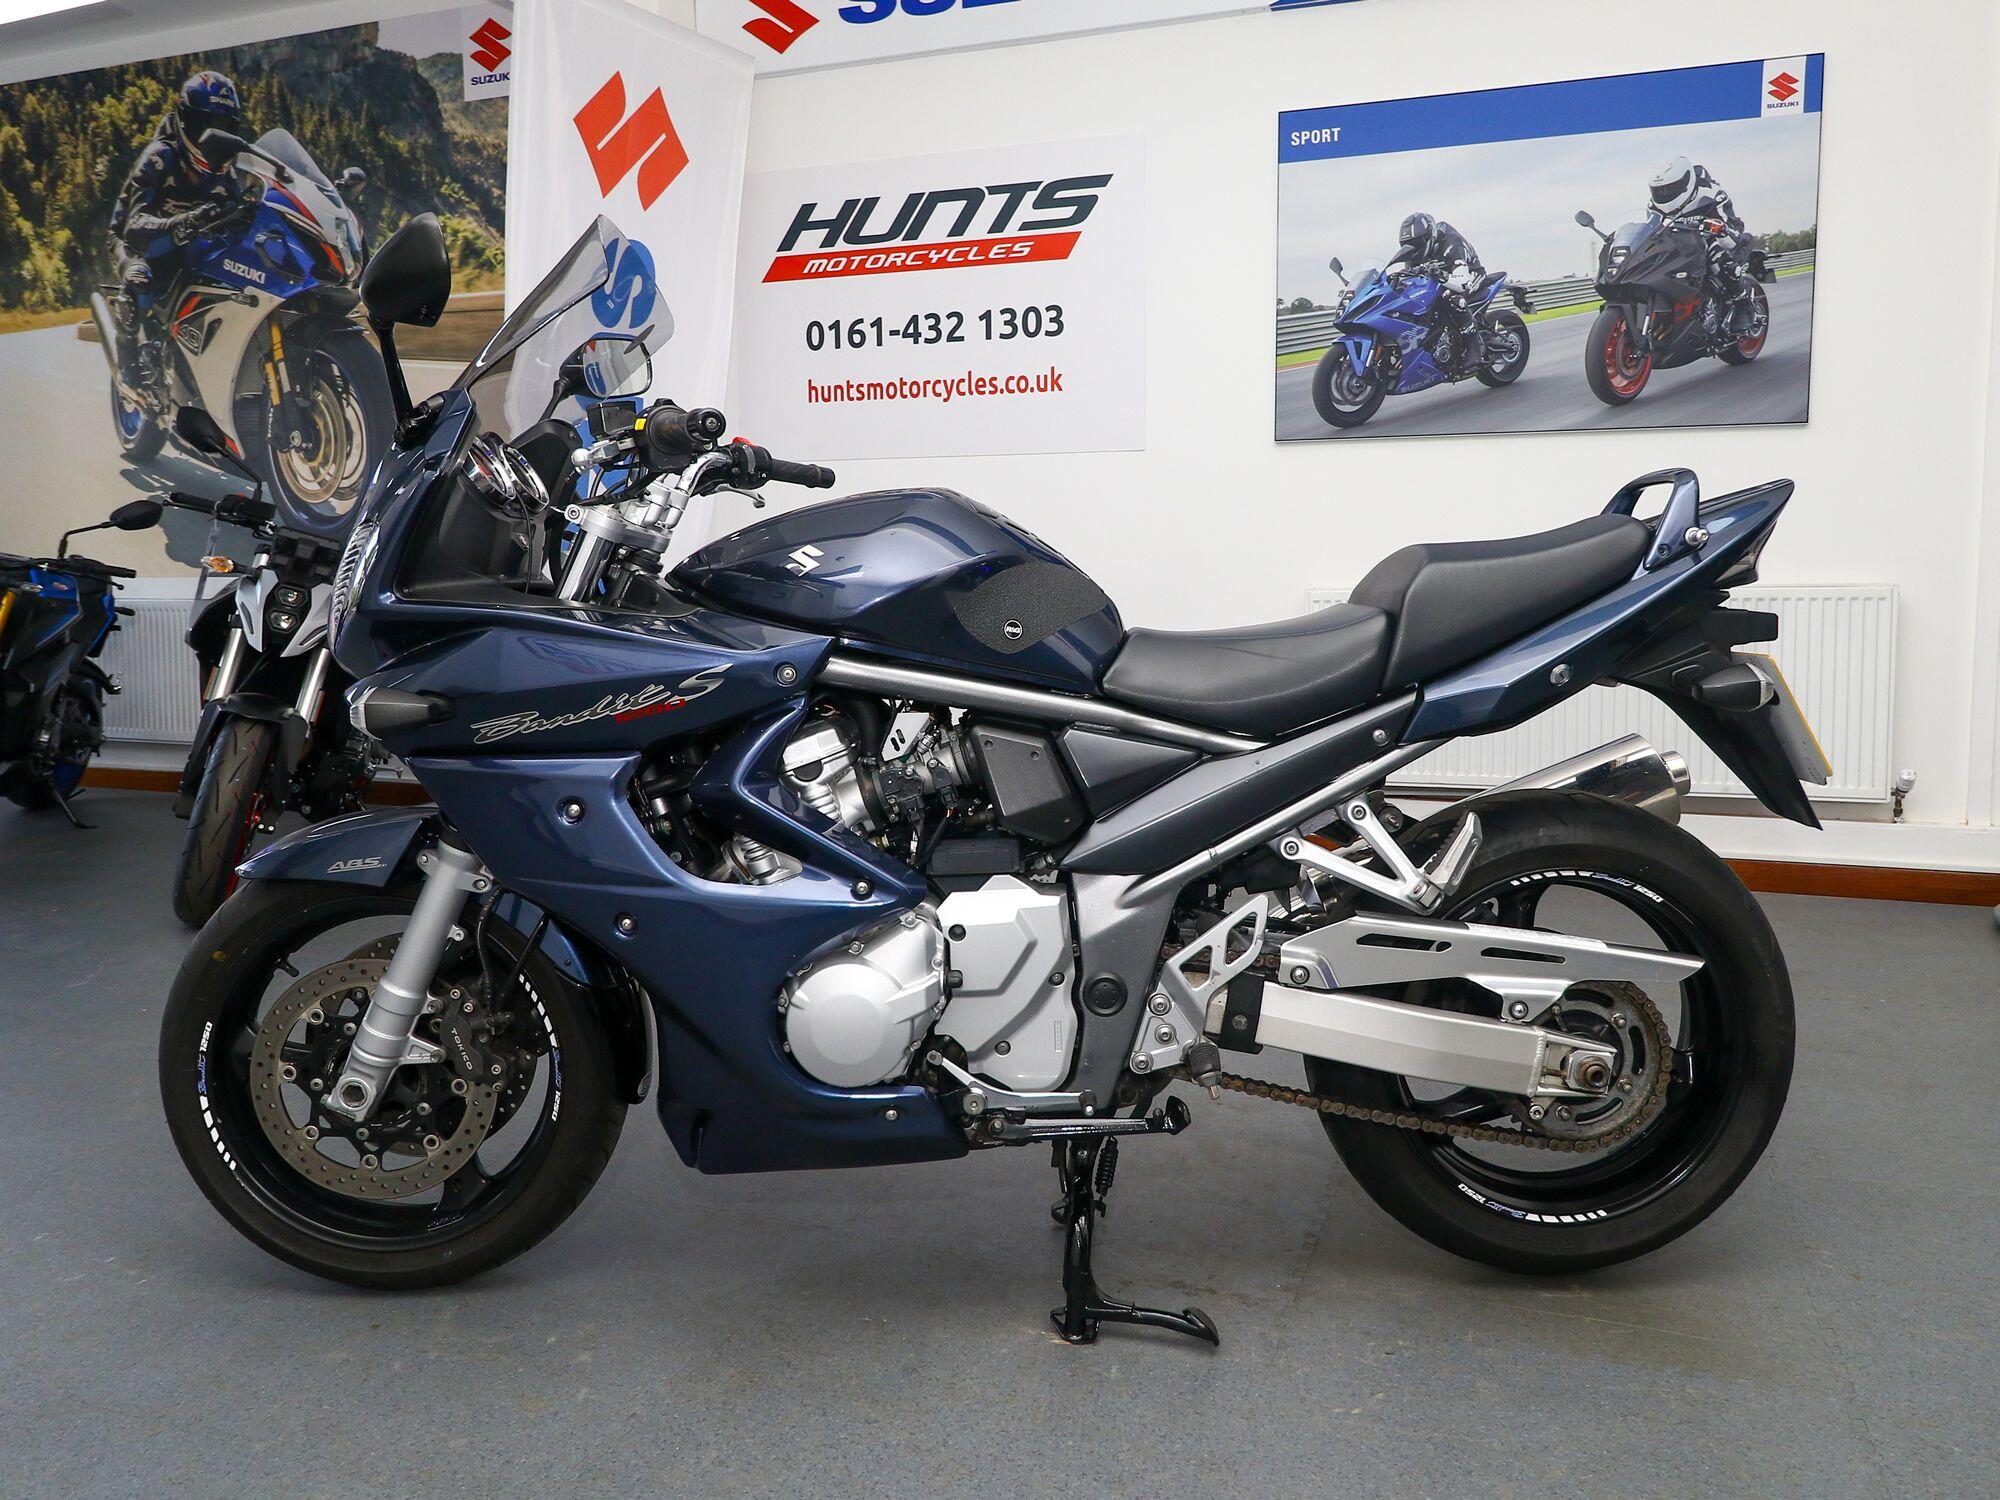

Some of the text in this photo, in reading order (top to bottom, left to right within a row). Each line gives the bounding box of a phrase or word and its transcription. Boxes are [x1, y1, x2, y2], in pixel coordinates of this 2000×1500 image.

[470, 72, 511, 86] SUZUK
[1766, 101, 1799, 109] SUZUKI
[1290, 127, 1341, 146] SPORT
[776, 174, 1114, 252] HUNTS
[223, 259, 266, 285] SUZUKI
[802, 242, 1035, 275] MOTORCYCLES
[805, 304, 1065, 351] 0161-432 1303
[807, 366, 1064, 404] huntsmotorcycles.co.uk
[471, 662, 734, 744] Bandit S
[327, 857, 382, 872] ABS
[1632, 883, 1664, 903] 1250
[199, 1021, 213, 1052] 1250
[451, 1027, 473, 1071] TOKICO
[1457, 1182, 1487, 1204] 1250
